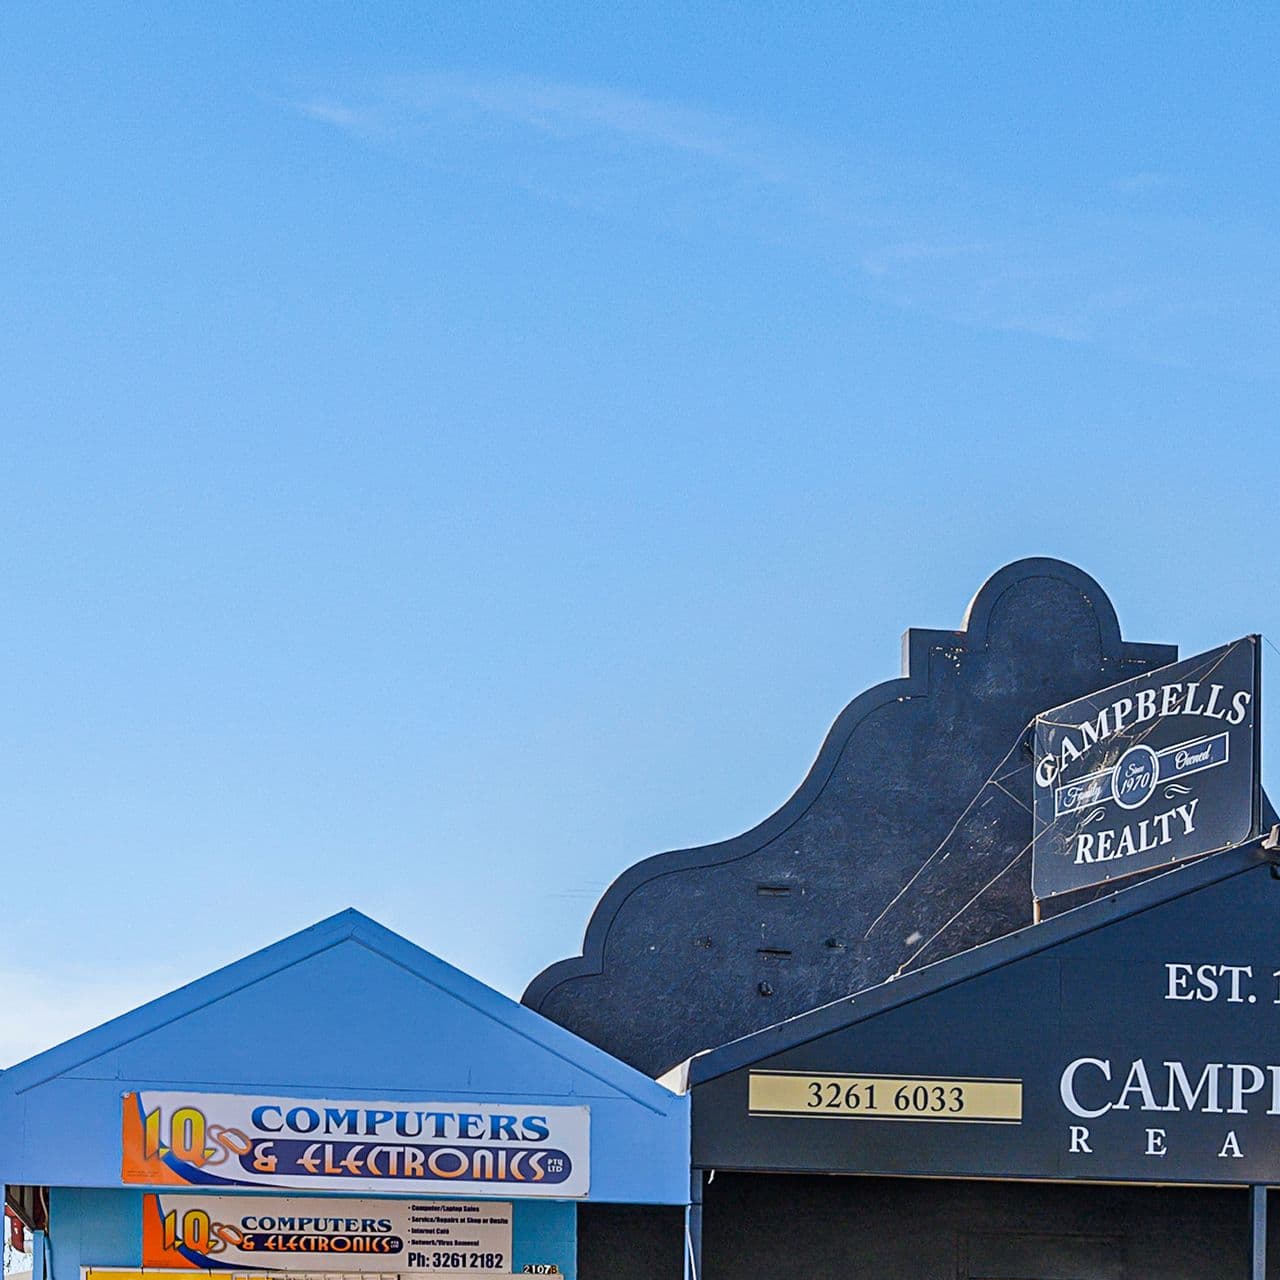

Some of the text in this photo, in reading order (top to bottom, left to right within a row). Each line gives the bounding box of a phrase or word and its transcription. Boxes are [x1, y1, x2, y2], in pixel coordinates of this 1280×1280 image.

[1035, 682, 1251, 788] CAMPBELLS
[1121, 771, 1151, 795] 1970
[1073, 798, 1199, 865] REALTY
[1164, 962, 1256, 1004] EST.
[806, 1081, 965, 1112] 3261 6033
[251, 1105, 550, 1142] COMPUTERS
[253, 1141, 548, 1181] & ELECTRONICS
[547, 1165, 563, 1173] LTD
[241, 1215, 393, 1233] COMPUTERS
[242, 1234, 391, 1252] & ELECTRONICS
[407, 1252, 504, 1269] Ph: 3261 2182
